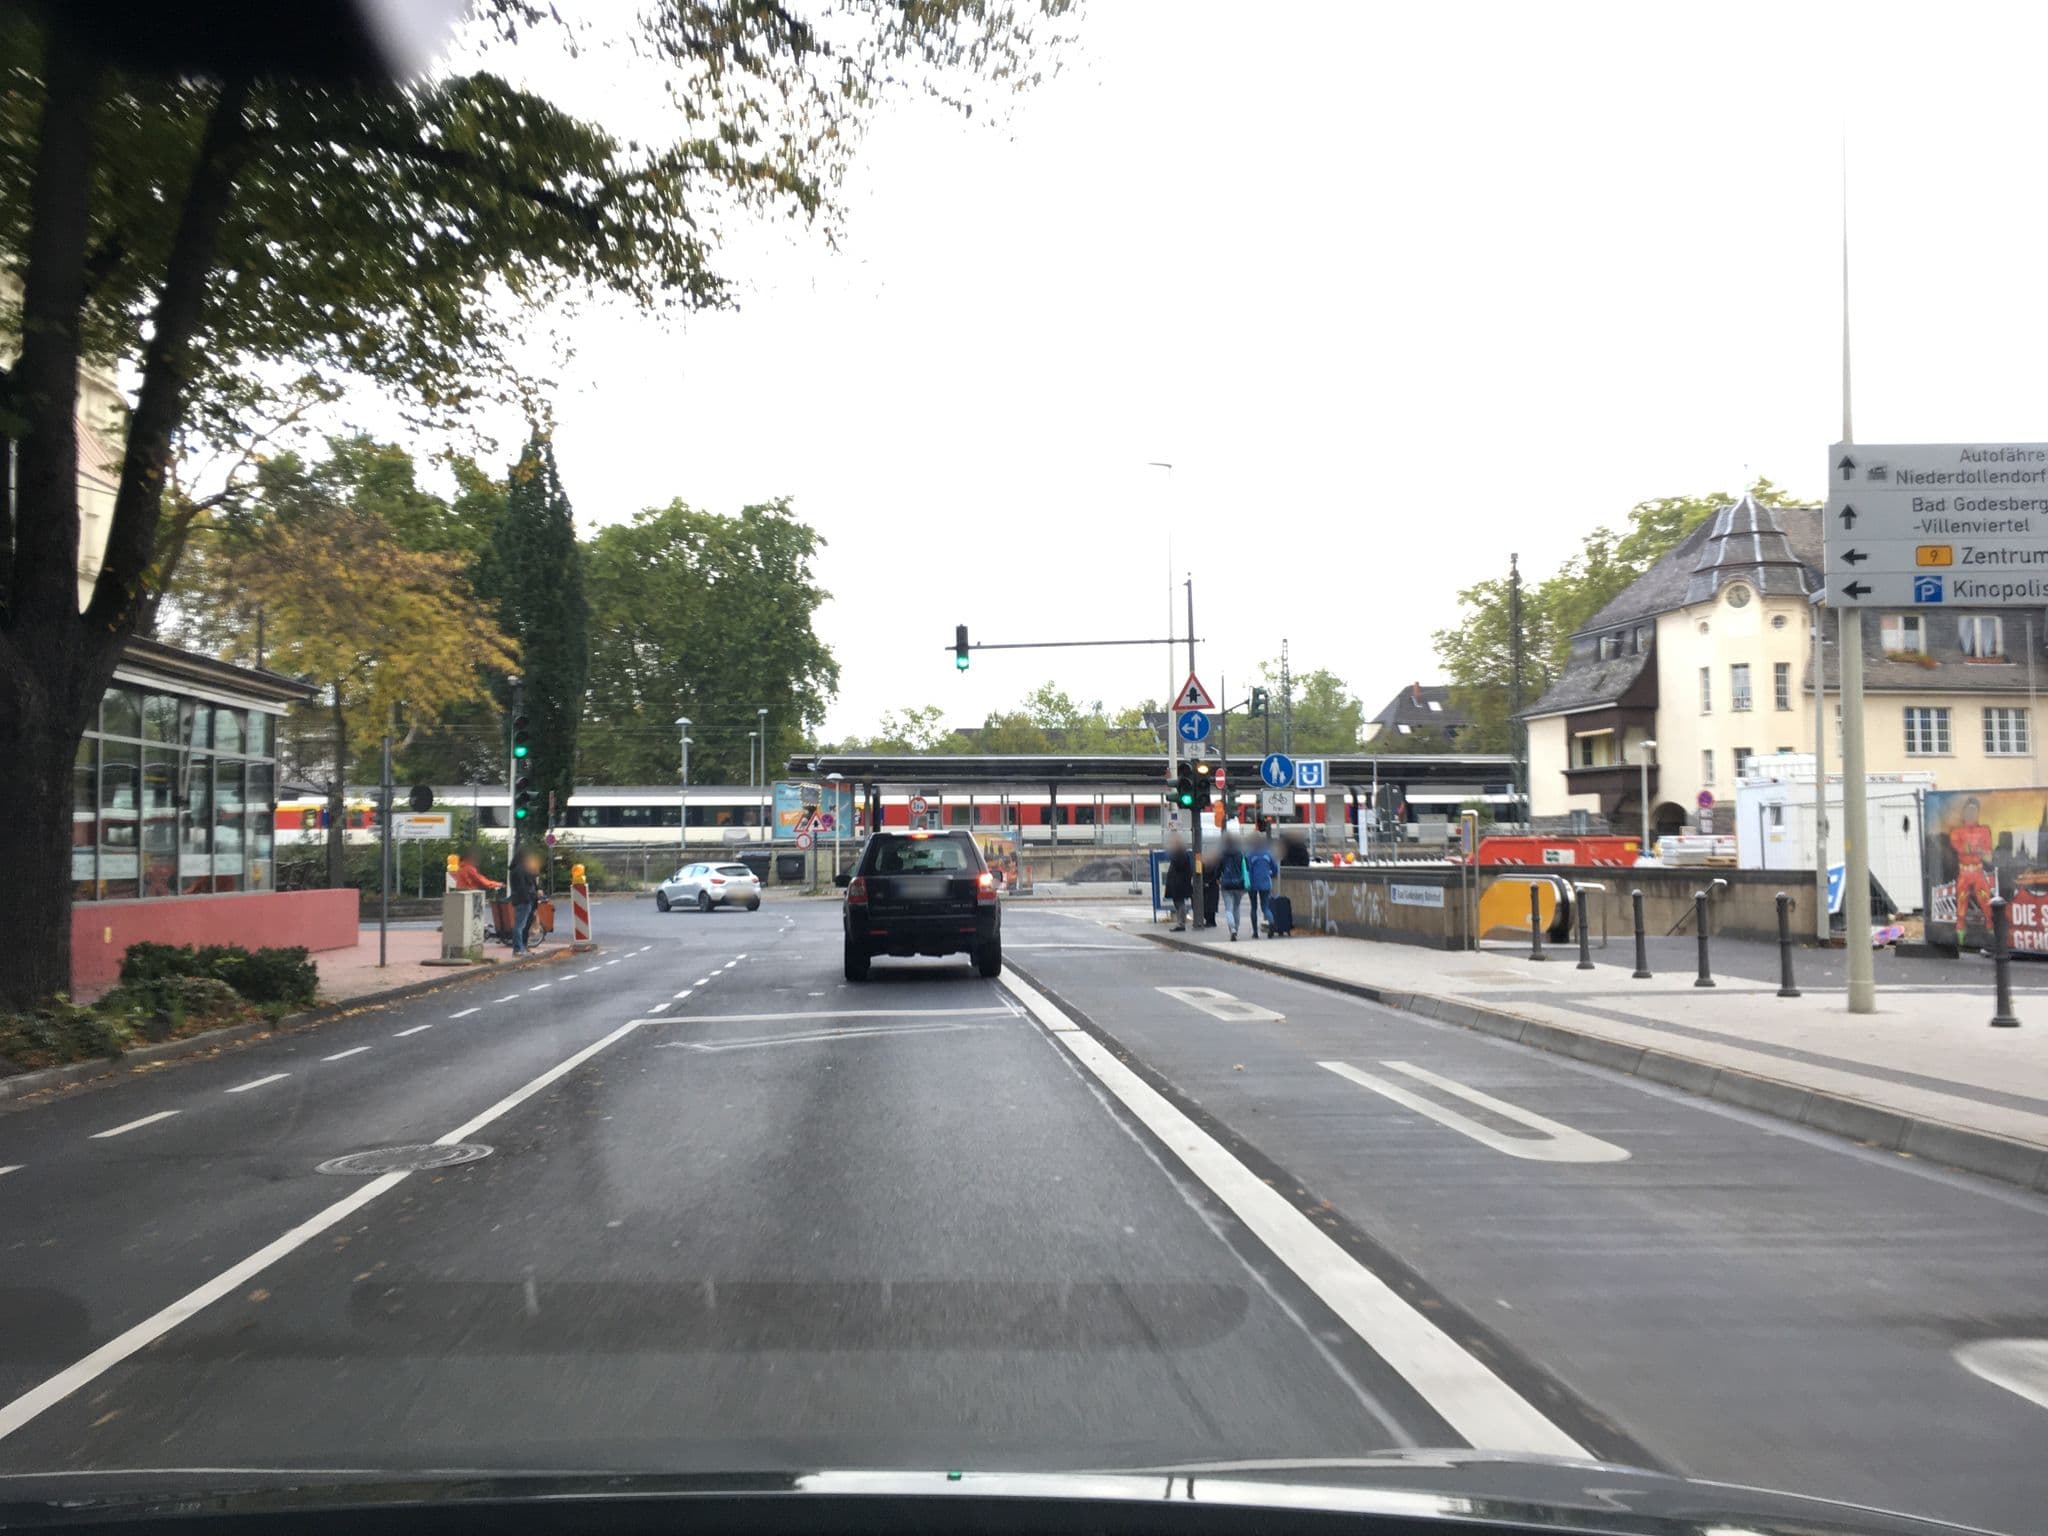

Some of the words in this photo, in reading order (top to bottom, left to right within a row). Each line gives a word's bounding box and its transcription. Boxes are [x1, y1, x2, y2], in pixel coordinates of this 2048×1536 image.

[1959, 447, 2046, 463] Autofähre
[1896, 468, 2046, 485] Niederdollendorf
[1912, 497, 1945, 512] Bad
[1953, 496, 2048, 515] Godesberg
[1913, 517, 2030, 534] -Villenviertel
[1930, 549, 1938, 562] 9
[2012, 903, 2037, 926] DIE
